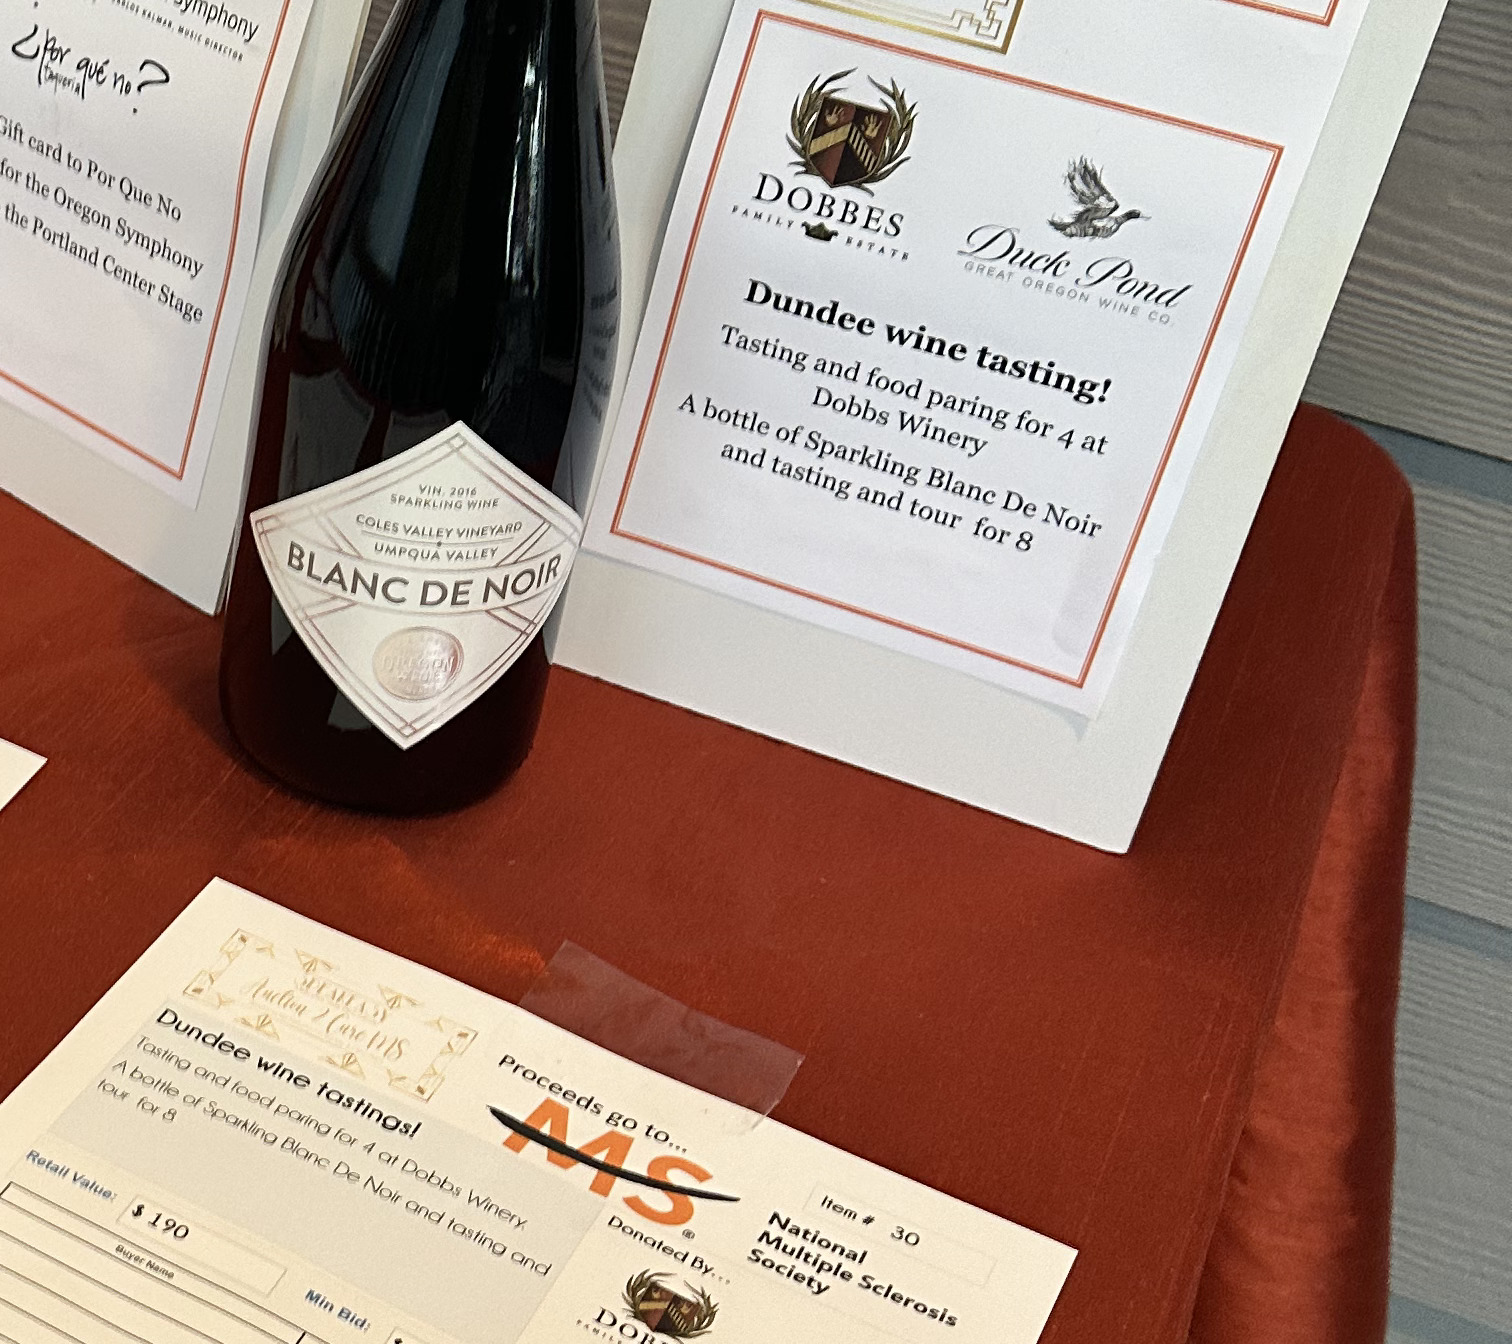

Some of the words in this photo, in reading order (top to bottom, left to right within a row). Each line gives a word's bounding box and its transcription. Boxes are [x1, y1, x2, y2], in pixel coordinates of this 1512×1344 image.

[28, 136, 63, 164] card
[67, 151, 82, 173] to
[87, 159, 116, 188] Por
[119, 176, 153, 206] Que
[156, 193, 181, 222] No
[754, 172, 904, 237] DOBBES
[0, 158, 22, 184] for
[25, 172, 50, 198] the
[53, 186, 111, 230] Oregon
[115, 217, 204, 279] Symphony
[731, 205, 794, 229] FAMILY
[845, 236, 909, 261] ESTATE
[5, 203, 29, 229] the
[32, 216, 99, 268] Portland
[102, 254, 156, 296] Center
[157, 284, 203, 322] Stage
[958, 226, 1071, 277] Duck
[1074, 258, 1192, 308] Pond
[964, 260, 1014, 282] GREAT
[1021, 276, 1090, 303] OREGON
[1099, 297, 1140, 316] WINE
[1146, 308, 1175, 327] CO.
[744, 278, 875, 336] Dundee
[886, 323, 968, 361] wine
[976, 346, 1112, 405] tasting!
[721, 324, 809, 372] Tasting
[813, 358, 862, 383] and
[866, 367, 923, 400] food
[925, 389, 1010, 430] paring
[1014, 410, 1054, 437] for
[1057, 429, 1075, 450] 4
[1080, 435, 1108, 455] at
[812, 386, 890, 426] Dobbs
[899, 410, 989, 458] Winery
[390, 493, 463, 510] SPARKLING
[468, 497, 500, 510] WINE
[450, 487, 478, 497] 2016
[678, 393, 695, 414] A
[702, 396, 770, 435] bottle
[775, 425, 805, 444] of
[803, 430, 921, 486] Sparkling
[926, 467, 996, 505] Blanc
[1002, 490, 1037, 518] De
[1042, 502, 1102, 537] Noir
[721, 444, 767, 468] and
[771, 456, 852, 500] tasting
[856, 486, 905, 511] and
[909, 498, 963, 529] tour
[973, 516, 1011, 544] for
[1015, 531, 1034, 552] 8
[355, 513, 399, 533] COLES
[403, 524, 454, 539] VALLEY
[457, 521, 523, 538] VINEYARD
[374, 542, 441, 561] UMPQUA
[447, 547, 499, 562] VALLEY
[287, 540, 410, 604] BLANC
[420, 579, 474, 606] DE
[482, 554, 562, 604] NOIR
[156, 1008, 251, 1060] Dundee
[257, 1056, 311, 1088] wine
[316, 1082, 422, 1138] tastings!
[498, 1054, 603, 1115] Proceeds
[605, 1111, 638, 1130] go
[645, 1124, 687, 1153] to...
[112, 1060, 127, 1075] A
[129, 1065, 180, 1097] bottle
[182, 1094, 204, 1108] of
[203, 1100, 279, 1146] Sparkling
[280, 1136, 331, 1166] Blanc
[332, 1160, 361, 1180] De
[363, 1175, 401, 1203] Noir
[405, 1200, 446, 1225] and
[447, 1217, 508, 1256] tasting
[510, 1251, 553, 1277] and
[502, 1097, 714, 1226] MS
[131, 1204, 145, 1217] $
[148, 1213, 189, 1239] 190
[768, 1211, 868, 1264] National
[821, 1195, 858, 1220] Item
[862, 1215, 875, 1225] #
[891, 1226, 920, 1246] 30
[747, 1248, 830, 1295] Society
[757, 1230, 853, 1282] Multiple
[857, 1274, 957, 1327] Sclerosis
